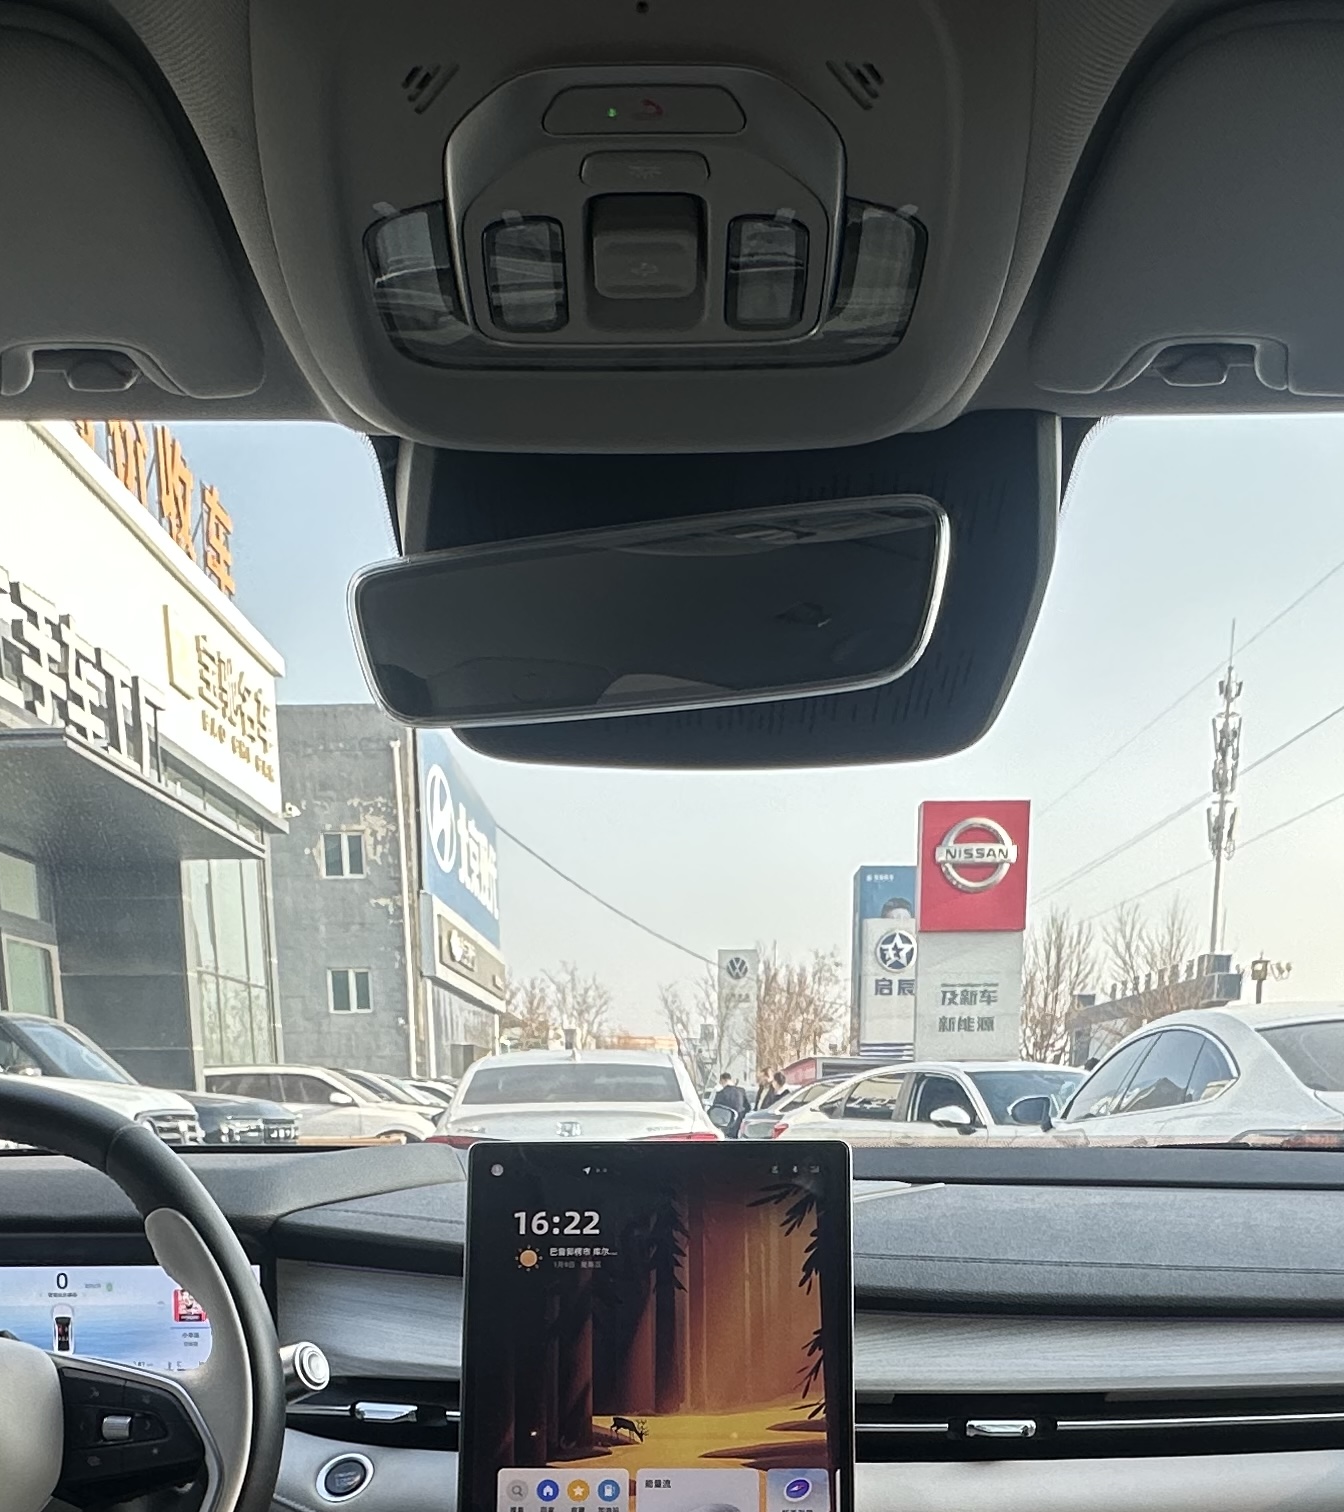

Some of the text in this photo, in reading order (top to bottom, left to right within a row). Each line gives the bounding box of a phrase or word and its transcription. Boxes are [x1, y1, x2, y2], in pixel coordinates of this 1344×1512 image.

[946, 848, 1009, 859] NISSAN
[875, 977, 916, 996] 启辰
[938, 1015, 994, 1032] 新能源
[514, 1211, 600, 1235] 16:22
[56, 1272, 68, 1289] 0
